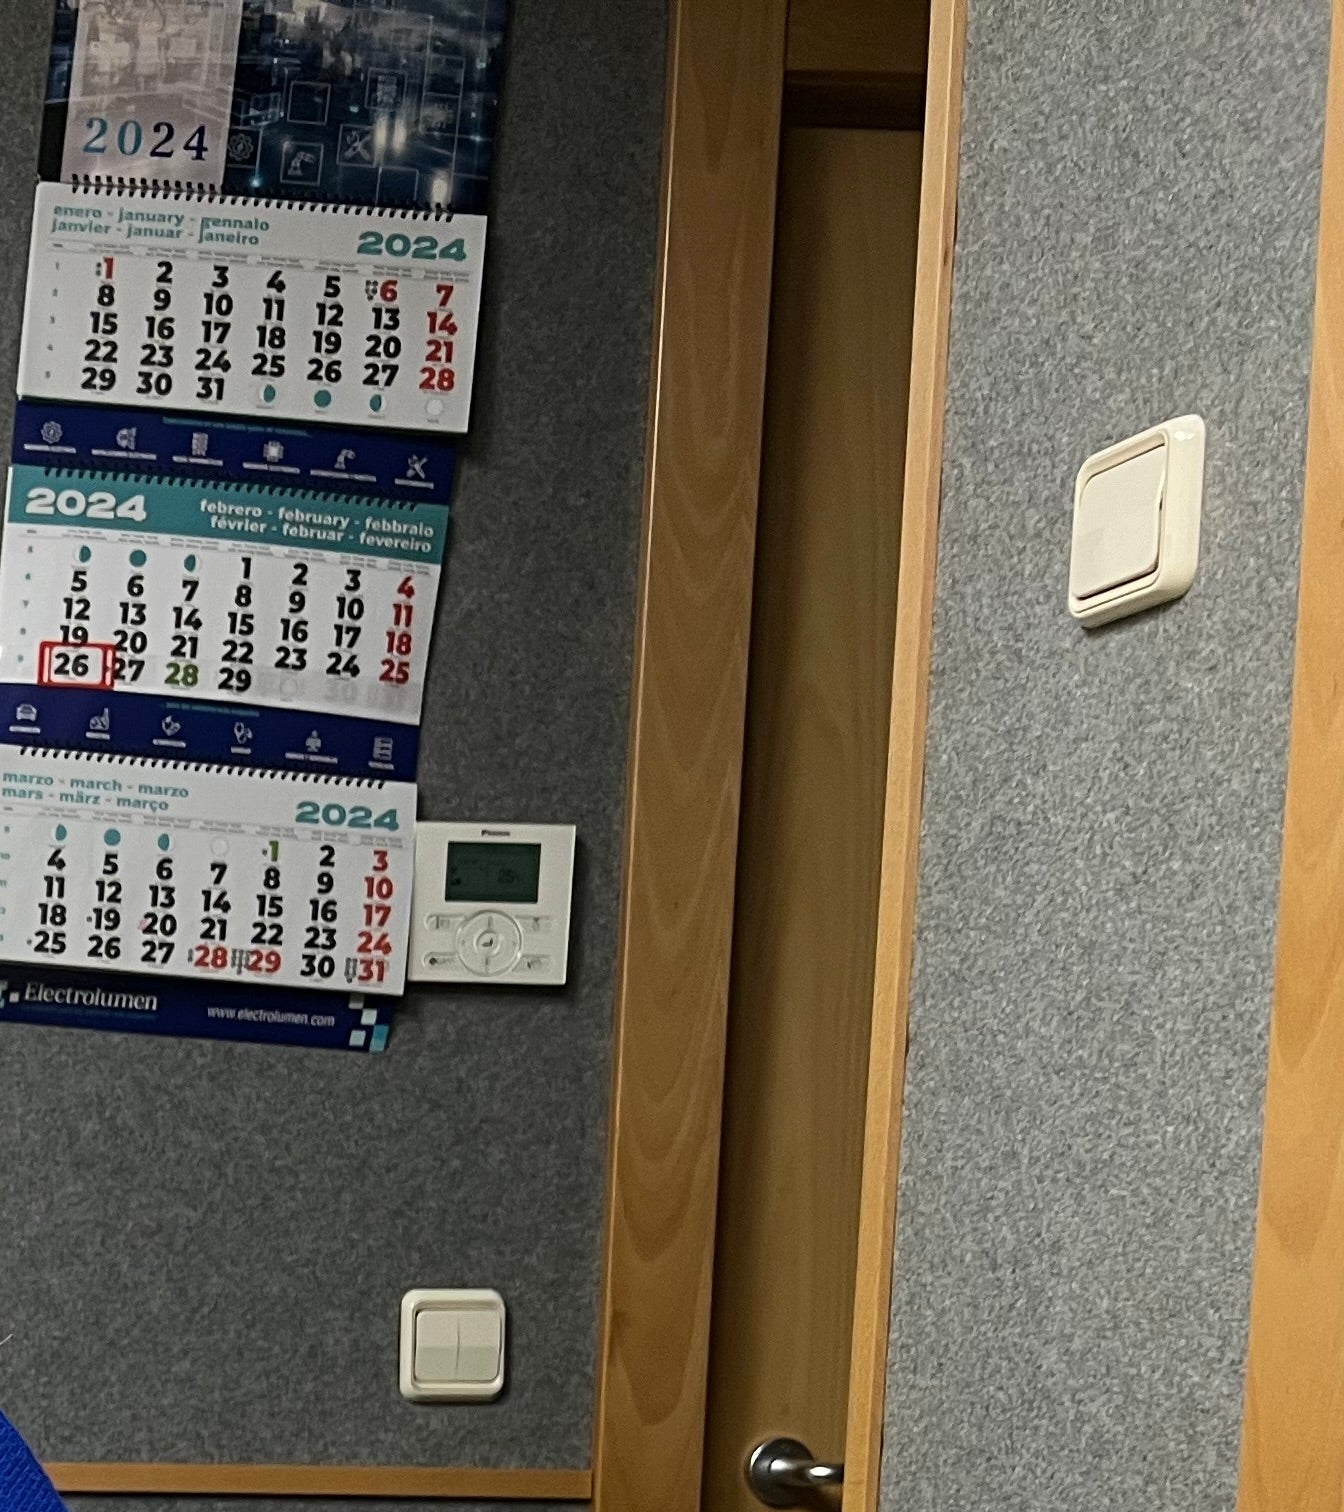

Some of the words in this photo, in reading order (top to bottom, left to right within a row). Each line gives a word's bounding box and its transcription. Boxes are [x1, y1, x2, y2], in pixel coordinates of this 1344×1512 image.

[82, 117, 208, 161] 2024
[52, 218, 110, 236] janvier
[127, 225, 183, 239] januar
[54, 204, 102, 218] enero
[118, 207, 184, 226] january
[357, 231, 466, 261] 2024
[103, 257, 114, 279] 1
[156, 260, 173, 284] 2
[211, 264, 229, 289] 3
[266, 270, 286, 294] 4
[323, 274, 341, 299] 5
[379, 279, 398, 303] 6
[435, 283, 454, 308] 7
[97, 283, 115, 307] 8
[153, 288, 172, 312] 9
[203, 292, 234, 317] 10
[262, 297, 286, 322] 11
[315, 302, 344, 328] 12
[371, 306, 400, 331] 13
[426, 311, 458, 336] 14
[90, 311, 118, 336] 15
[145, 315, 175, 340] 16
[201, 320, 232, 344] 17
[256, 324, 286, 350] 18
[312, 330, 342, 355] 19
[364, 334, 402, 359] 20
[425, 338, 454, 364] 21
[81, 366, 116, 391] 29
[135, 371, 173, 396] 30
[196, 376, 225, 401] 31
[84, 338, 118, 364] 22
[140, 343, 174, 368] 23
[194, 347, 232, 373] 24
[251, 352, 286, 378] 25
[306, 357, 342, 384] 26
[362, 362, 400, 387] 27
[418, 366, 455, 392] 28
[25, 487, 147, 523] 2024
[200, 498, 263, 519] febrero
[278, 506, 350, 529] february
[365, 515, 435, 538] febbraio
[210, 515, 267, 534] février
[282, 521, 344, 541] februar
[359, 532, 432, 553] fevereiro
[241, 557, 252, 580] 1
[291, 562, 308, 586] 2
[344, 568, 362, 592] 3
[397, 575, 415, 599] 4
[70, 570, 87, 592] 5
[127, 574, 144, 597] 6
[182, 579, 200, 602] 7
[234, 584, 252, 608] 8
[288, 590, 306, 614] 9
[336, 596, 365, 621] 10
[392, 603, 414, 628] 11
[63, 597, 91, 621] 12
[119, 601, 147, 626] 13
[172, 606, 203, 631] 14
[227, 611, 254, 636] 15
[280, 617, 309, 643] 16
[333, 623, 362, 649] 17
[386, 630, 412, 656] 18
[54, 652, 89, 677] 26
[113, 657, 145, 682] 27
[164, 662, 199, 687] 28
[217, 667, 252, 693] 29
[60, 625, 88, 647] 19
[113, 630, 148, 655] 20
[170, 634, 199, 659] 21
[221, 639, 254, 665] 22
[274, 645, 308, 671] 23
[325, 651, 361, 678] 24
[379, 658, 410, 685] 25
[2, 771, 55, 786] marzo
[70, 776, 123, 792] march
[138, 783, 190, 798] marzo
[2, 785, 44, 800] mars
[59, 788, 101, 805] märz
[116, 795, 170, 813] março
[295, 801, 400, 832] 2024
[47, 848, 66, 871] 4
[102, 853, 119, 876] 5
[156, 857, 173, 881] 6
[210, 862, 228, 885] 7
[263, 866, 281, 890] 8
[317, 871, 334, 895] 9
[364, 876, 394, 900] 10
[269, 840, 279, 862] 1
[319, 844, 336, 868] 2
[372, 850, 389, 872] 3
[43, 875, 65, 899] 11
[95, 880, 122, 904] 12
[148, 884, 176, 909] 13
[201, 889, 232, 914] 14
[256, 894, 284, 918] 15
[309, 898, 338, 923] 16
[363, 903, 392, 927] 17
[38, 902, 67, 927] 18
[92, 907, 121, 932] 19
[142, 912, 177, 937] 20
[199, 916, 228, 942] 21
[250, 921, 284, 946] 22
[304, 926, 337, 951] 23
[357, 931, 392, 956] 24
[33, 930, 67, 955] 25
[87, 934, 121, 960] 26
[140, 940, 175, 964] 27
[194, 945, 228, 969] 28
[248, 949, 281, 973] 29
[299, 953, 336, 979] 30
[358, 958, 385, 982] 31
[24, 980, 158, 1011] Electrolumen
[207, 1005, 336, 1028] www.electrolumen.com
